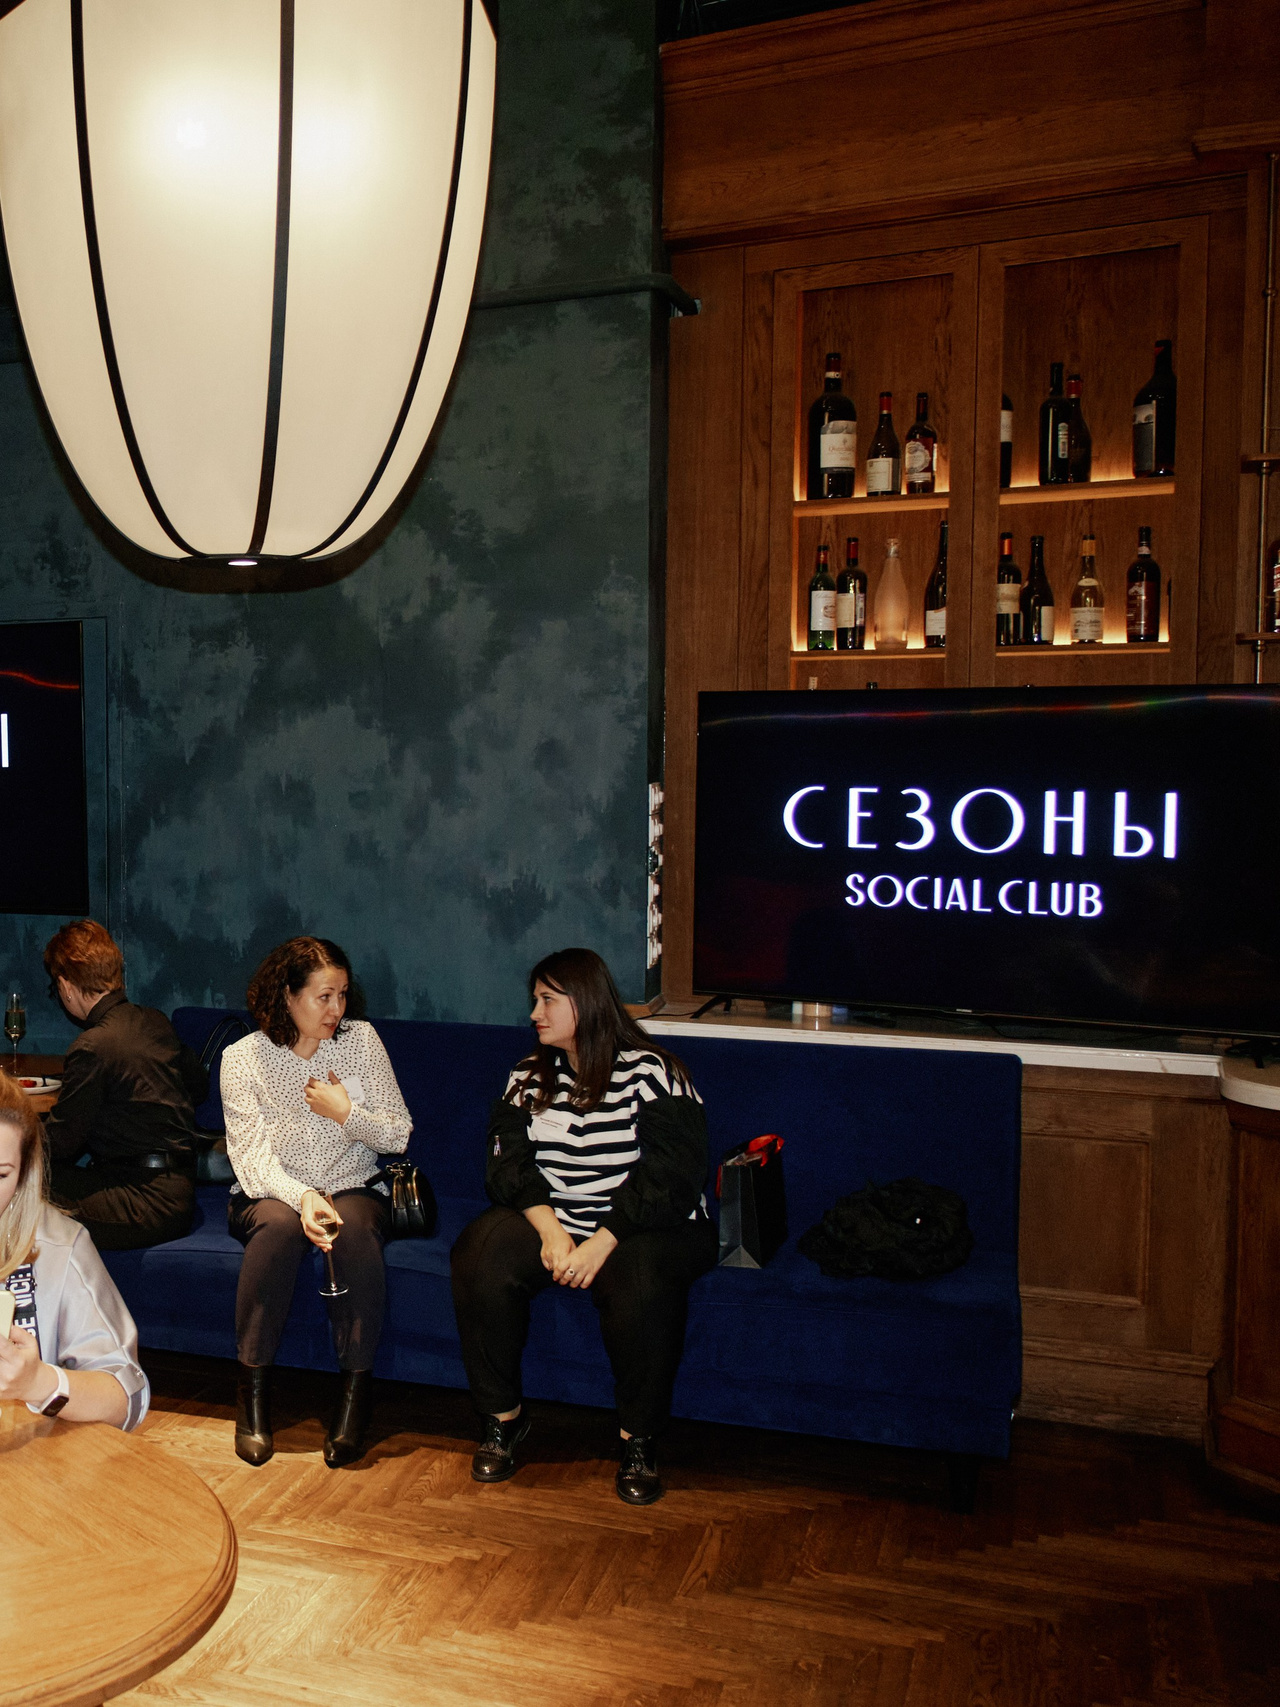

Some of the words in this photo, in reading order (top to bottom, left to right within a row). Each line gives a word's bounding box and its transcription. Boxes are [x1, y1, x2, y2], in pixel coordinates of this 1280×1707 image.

[782, 785, 1179, 859] СЕЗОНЫ
[844, 873, 992, 913] SOCIAL
[998, 879, 1103, 918] CLUB
